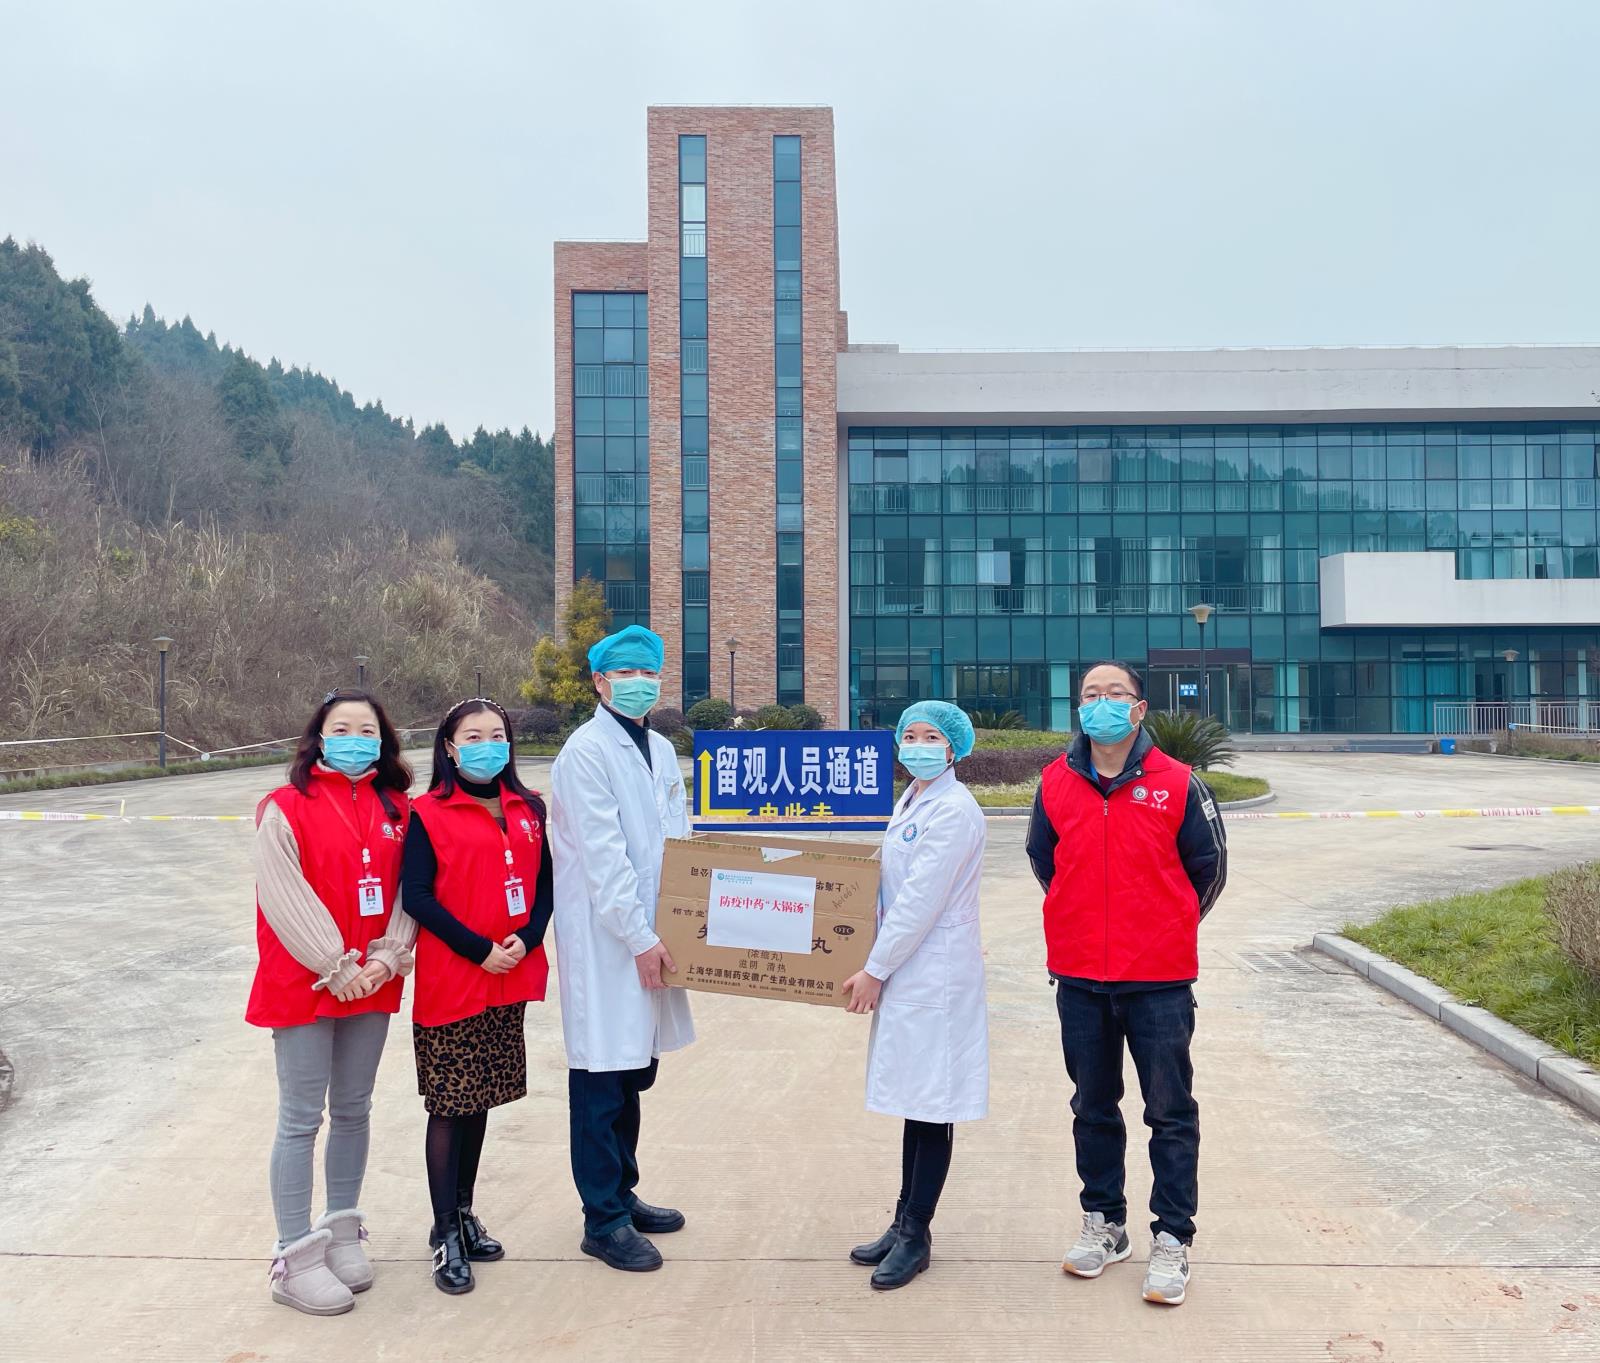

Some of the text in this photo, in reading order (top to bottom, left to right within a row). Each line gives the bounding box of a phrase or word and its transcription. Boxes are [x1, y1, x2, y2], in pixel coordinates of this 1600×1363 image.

[716, 745, 880, 796] 留观人员通道
[719, 895, 810, 914] 防疫中药“大锅汤”
[834, 925, 855, 936] OTC
[687, 963, 834, 991] 上海华源制药安徽广生药业有限公司
